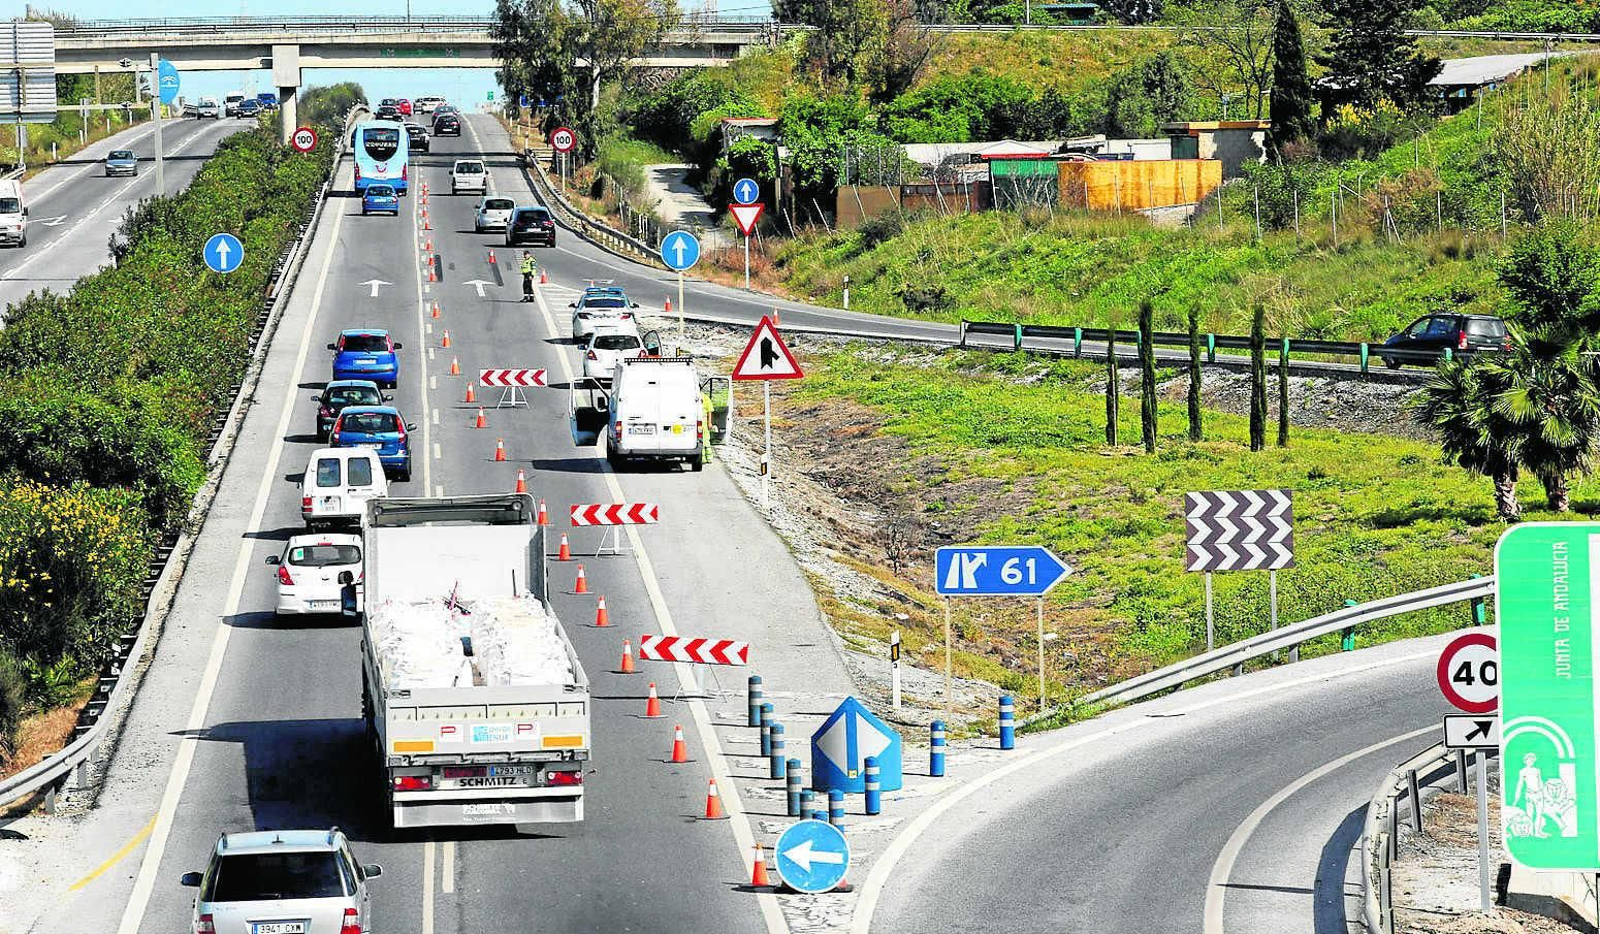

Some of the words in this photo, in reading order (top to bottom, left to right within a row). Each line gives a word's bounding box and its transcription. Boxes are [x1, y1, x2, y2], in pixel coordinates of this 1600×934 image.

[297, 135, 313, 144] 100
[556, 135, 571, 145] 100
[1000, 557, 1036, 585] 61
[1554, 616, 1570, 632] DE
[1555, 638, 1571, 679] JUNTA
[1453, 660, 1498, 687] 40
[460, 777, 517, 787] SCHMITZ
